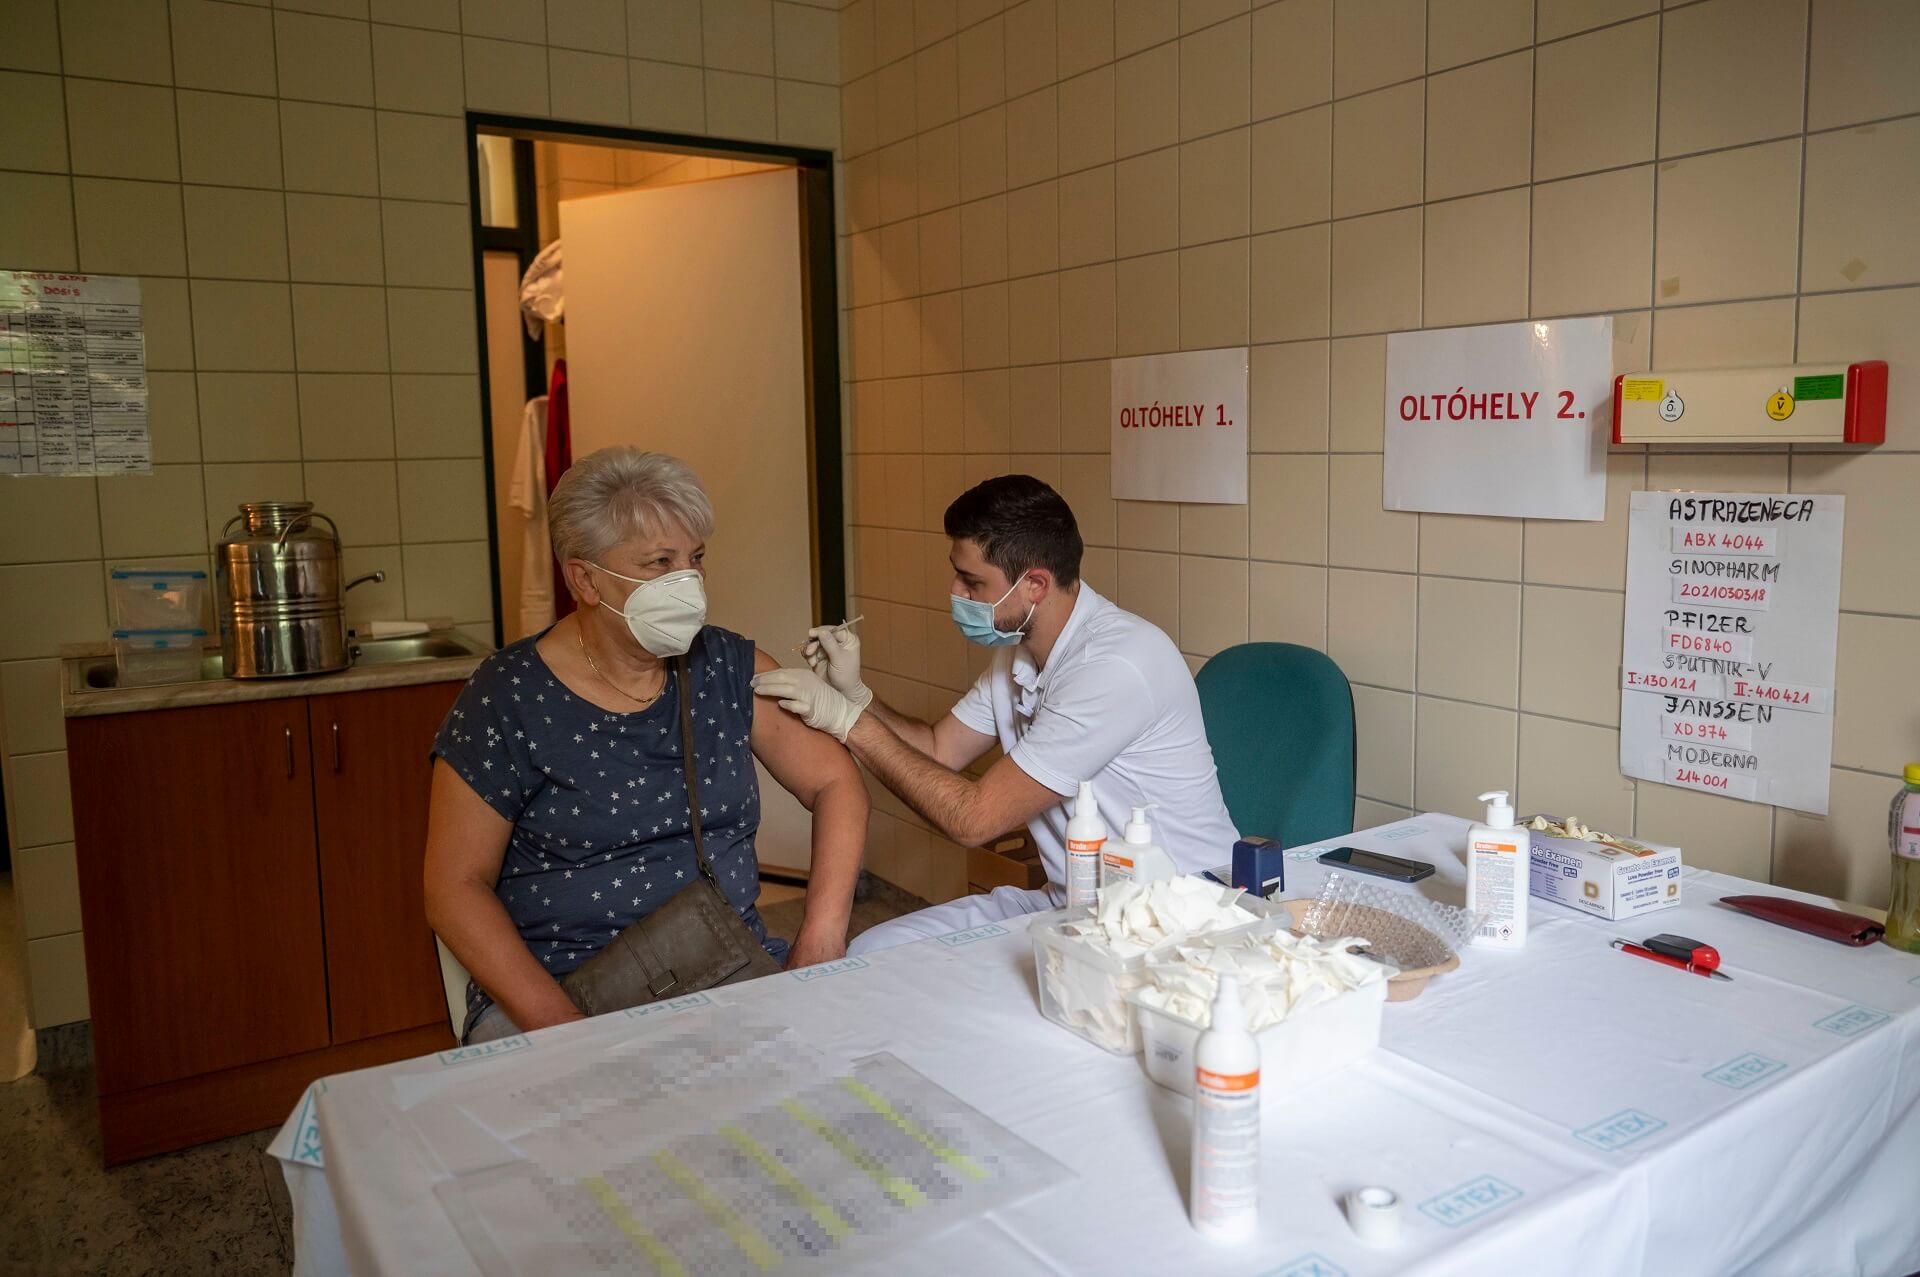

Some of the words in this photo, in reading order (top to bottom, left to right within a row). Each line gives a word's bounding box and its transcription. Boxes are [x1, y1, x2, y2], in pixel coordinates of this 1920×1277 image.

[43, 286, 81, 296] DOSIS
[1119, 401, 1204, 429] OLTÓHELY
[1216, 404, 1234, 427] 1.
[1398, 386, 1540, 422] OLTÓHELY
[1556, 390, 1585, 420] 2.
[1669, 497, 1815, 524] ASTRAZENECA
[1668, 559, 1781, 584] SINOPHARM
[1680, 583, 1766, 602] 2021030318
[1664, 609, 1755, 634] PFIZER
[1670, 633, 1733, 654] FD6840
[1664, 695, 1773, 724] JANSSEN
[1667, 743, 1758, 771] MODERNA
[1531, 845, 1544, 858] de
[1545, 849, 1583, 869] Examen
[1434, 1182, 1507, 1219] H-TEX
